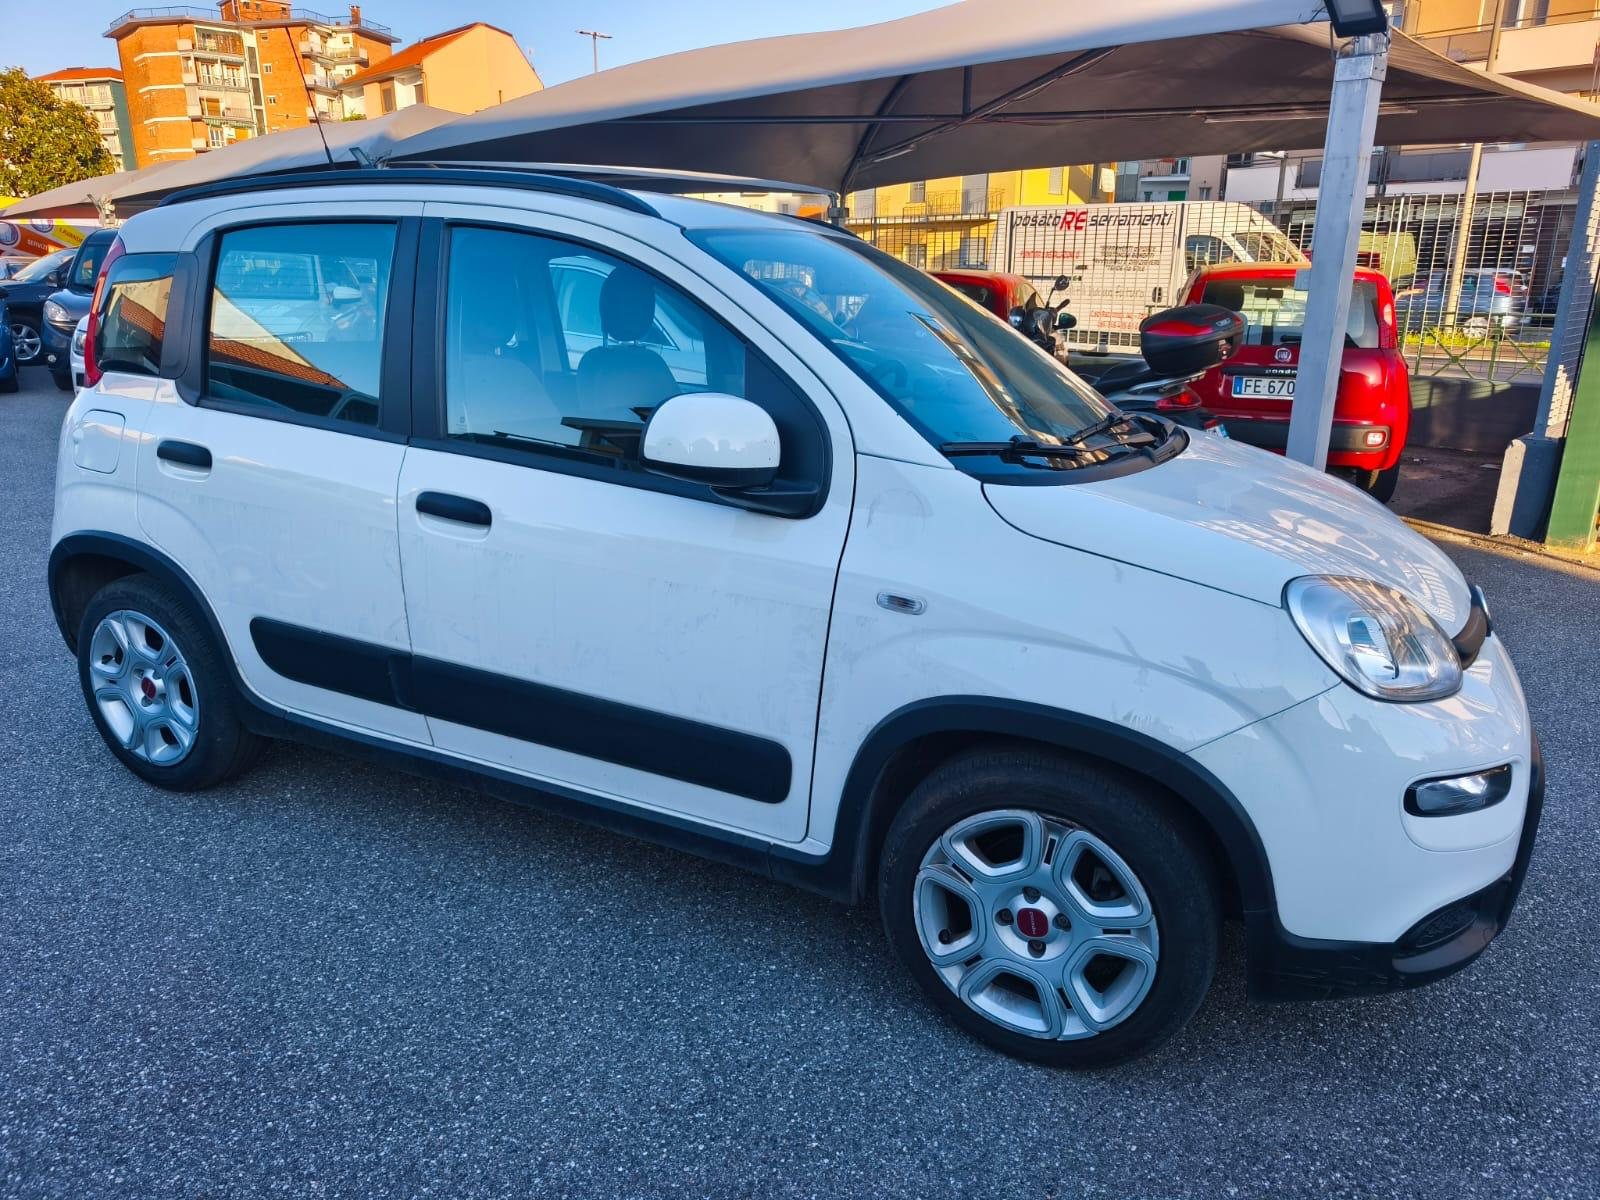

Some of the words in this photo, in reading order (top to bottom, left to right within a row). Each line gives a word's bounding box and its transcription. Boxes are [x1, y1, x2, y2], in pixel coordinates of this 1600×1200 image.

[1089, 210, 1174, 227] serramenti
[1244, 379, 1262, 394] FE
[1267, 380, 1295, 395] 670
